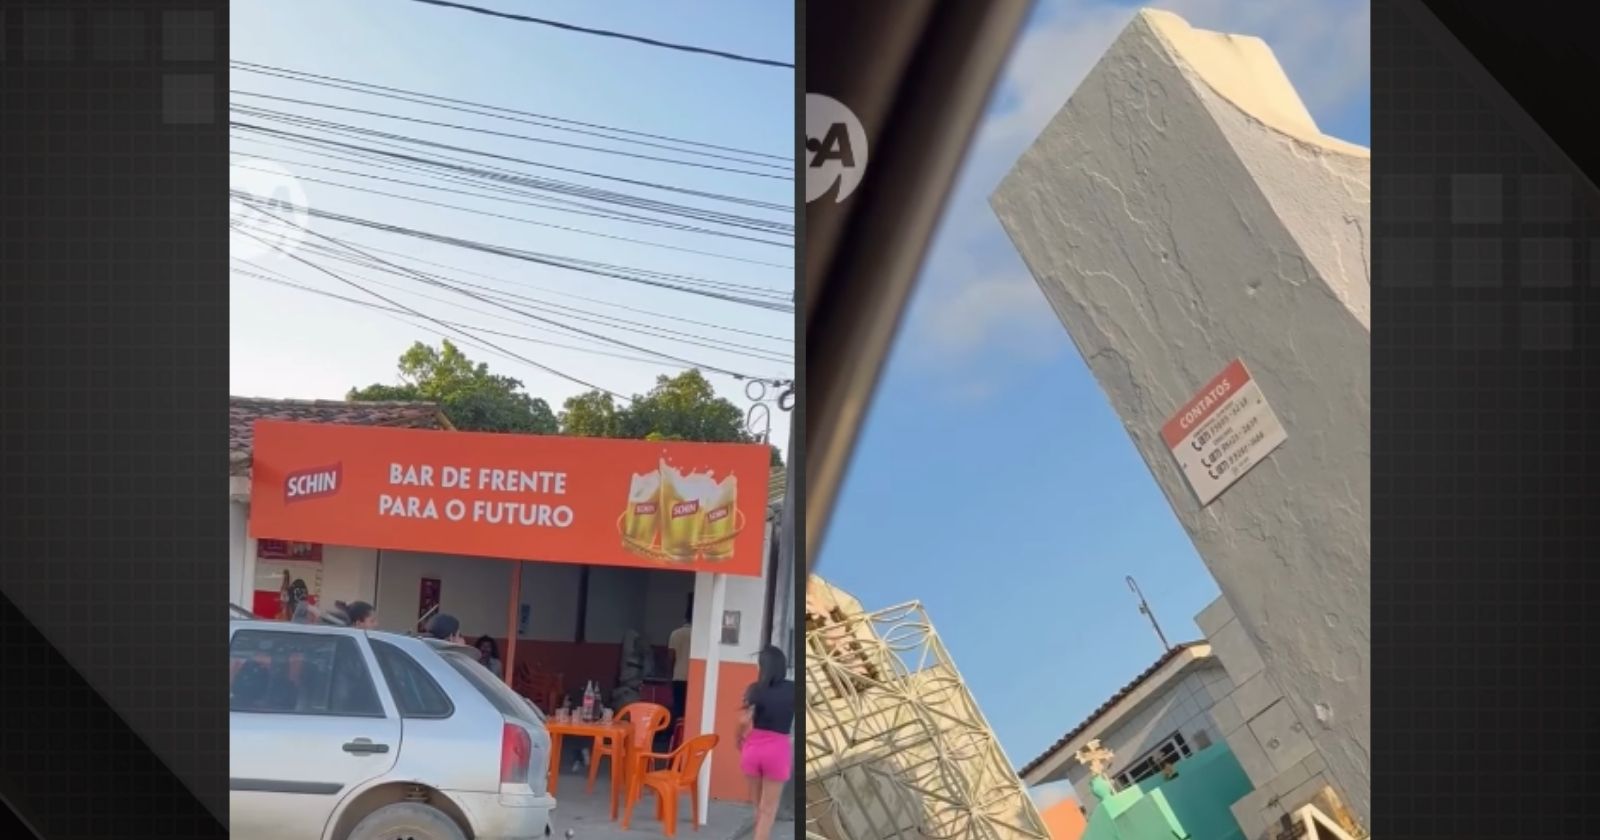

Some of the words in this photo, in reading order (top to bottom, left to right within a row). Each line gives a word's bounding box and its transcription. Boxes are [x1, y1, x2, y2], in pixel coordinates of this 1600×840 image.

[1179, 378, 1231, 429] CONTATOS
[287, 470, 337, 497] SCHIN
[389, 463, 434, 487] BAR
[441, 466, 471, 489] DE
[478, 468, 567, 494] FRENTE
[379, 494, 439, 520] PARA
[445, 499, 466, 521] O
[473, 501, 574, 528] FUTURO
[674, 503, 697, 515] SCHIN
